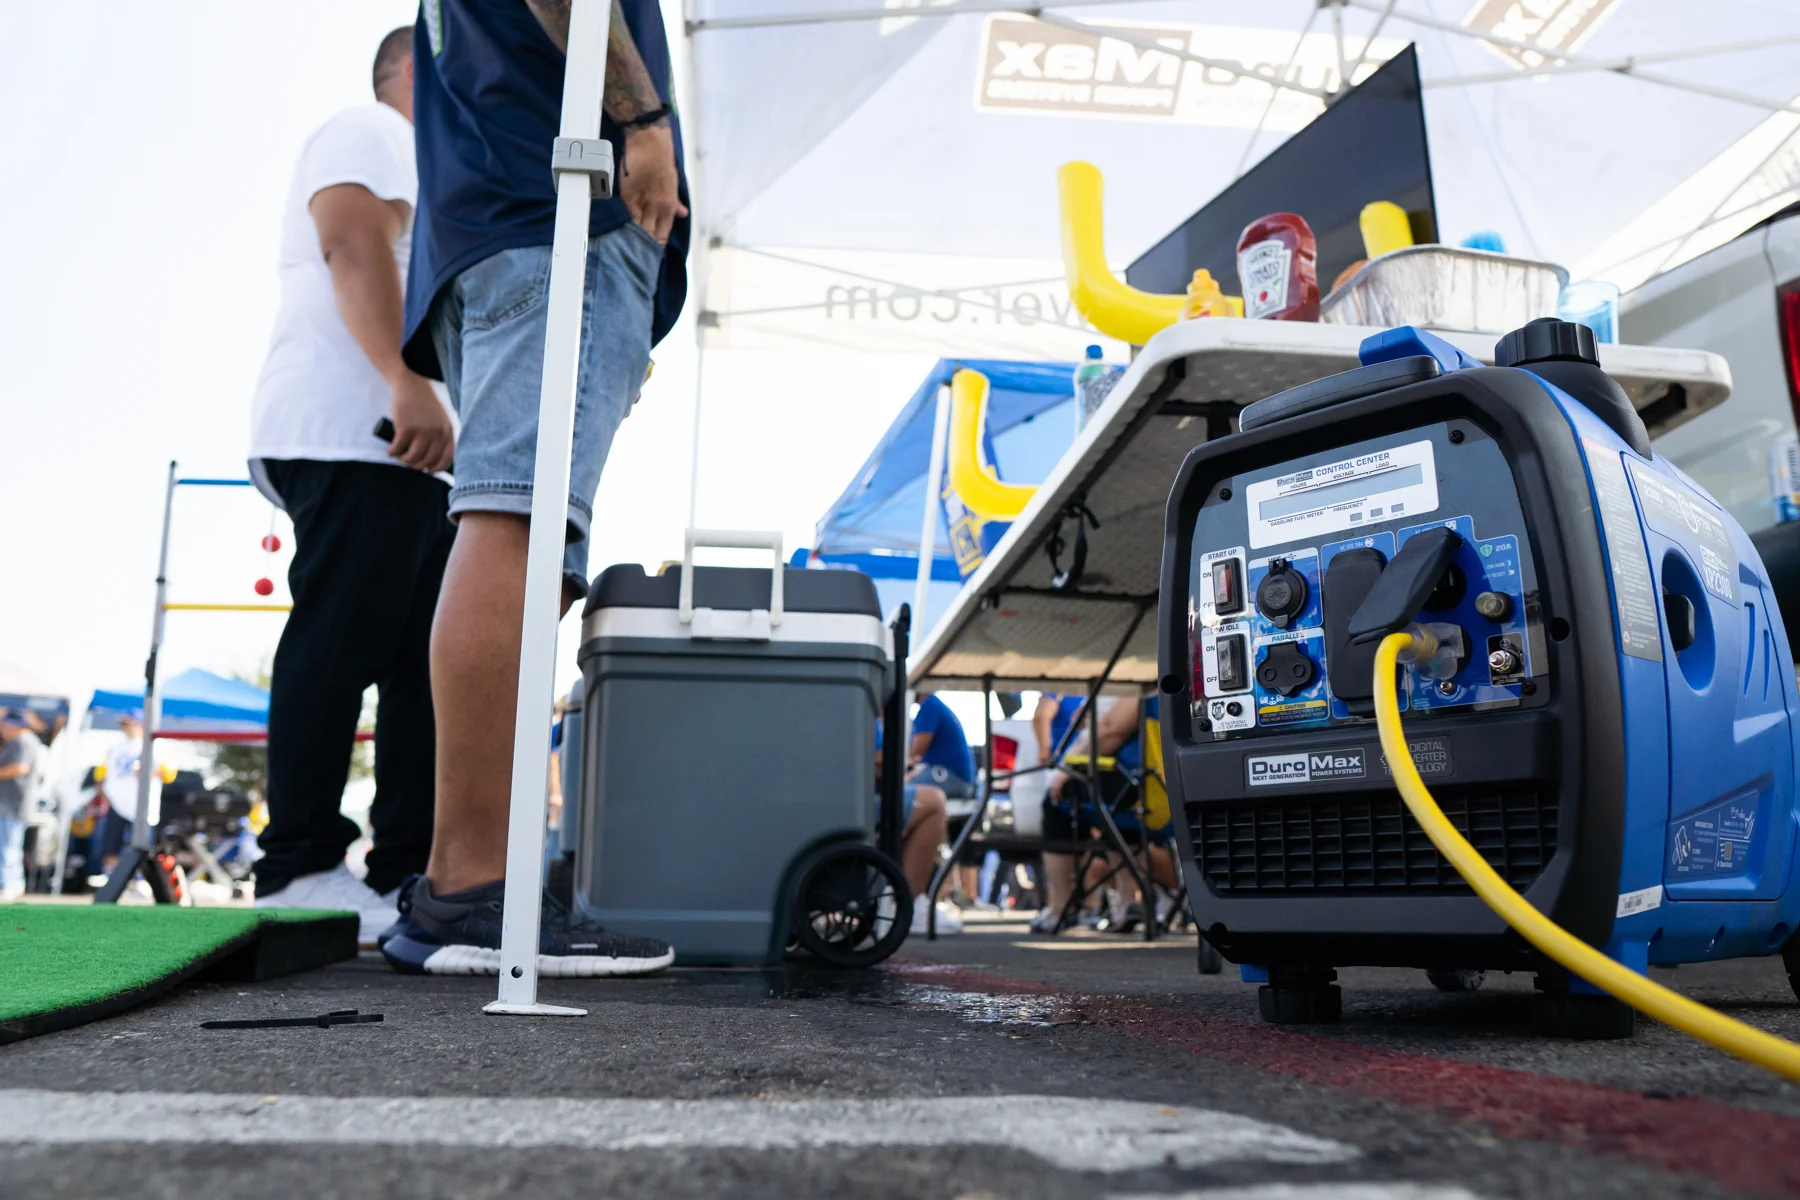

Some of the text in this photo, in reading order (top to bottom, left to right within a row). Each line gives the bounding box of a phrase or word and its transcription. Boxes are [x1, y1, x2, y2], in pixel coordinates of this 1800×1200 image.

[1316, 461, 1355, 477] CONTROL
[1356, 452, 1390, 467] CENTER
[1333, 470, 1355, 479] VOLTAGE
[1376, 461, 1390, 469] LOAD
[1270, 502, 1364, 527] GASOLINE FUEL METER FREQUENCY
[1495, 543, 1512, 552] 20A
[1208, 548, 1237, 560] START UP
[1226, 623, 1240, 631] IDLE
[1271, 633, 1305, 643] PARALLEL
[1206, 675, 1219, 683] OFF
[1284, 702, 1306, 710] CAUTION
[1409, 741, 1446, 753] DIGITAL
[1413, 751, 1447, 763] ERTER
[1269, 772, 1307, 780] GENERATION
[1312, 769, 1333, 777] POWER
